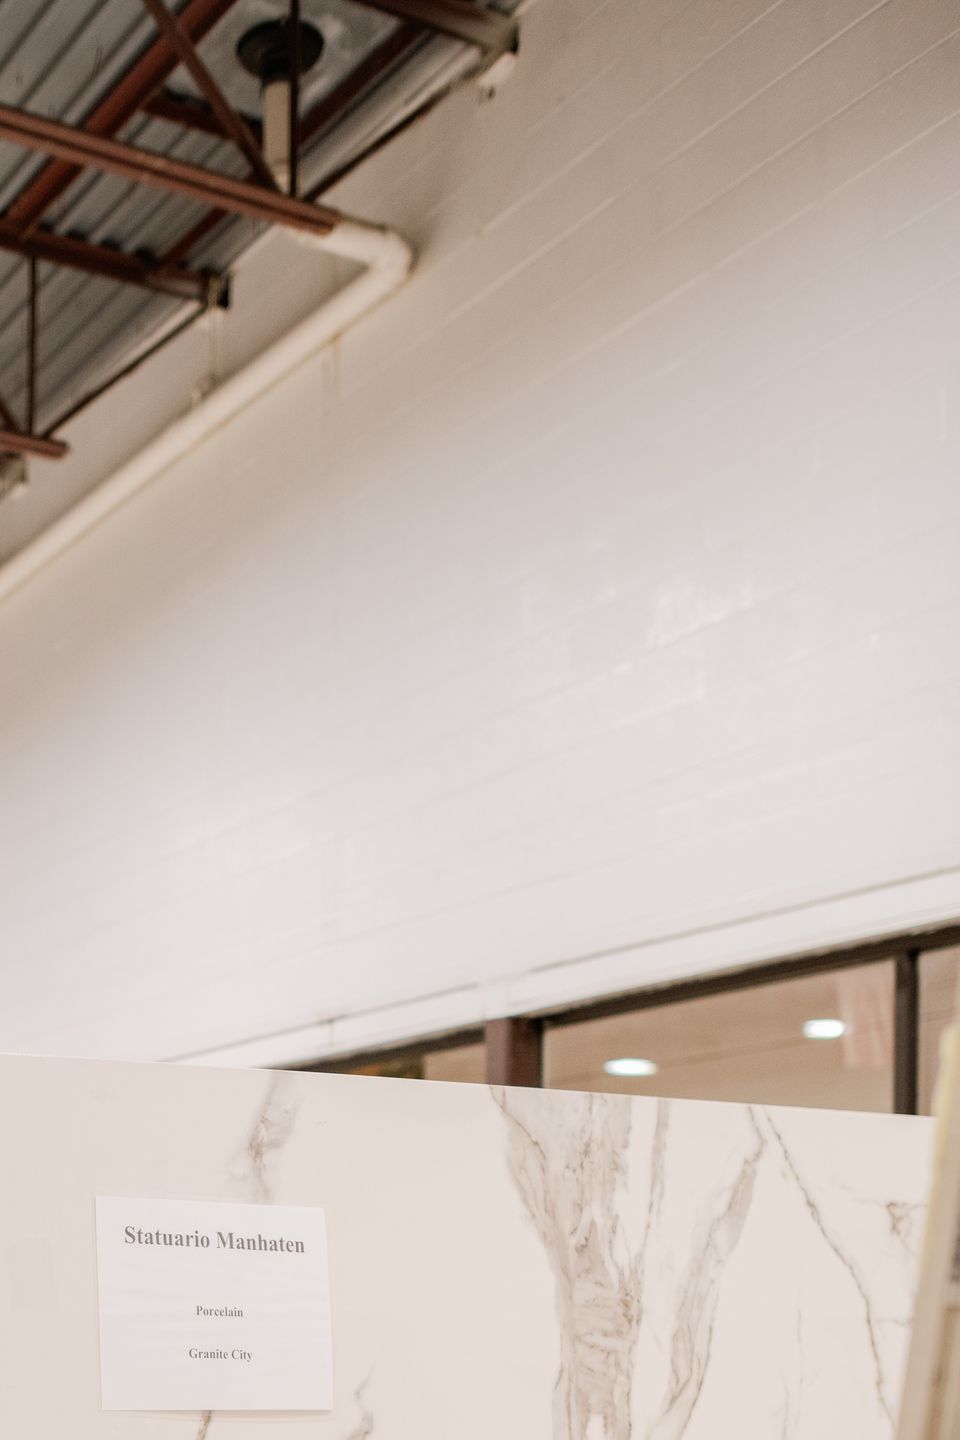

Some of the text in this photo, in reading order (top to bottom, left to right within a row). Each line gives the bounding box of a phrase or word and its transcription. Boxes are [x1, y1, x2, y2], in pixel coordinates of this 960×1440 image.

[123, 1224, 306, 1254] Statuario Manhaten
[196, 1305, 244, 1318] Porcelain
[188, 1347, 253, 1363] Granite City
